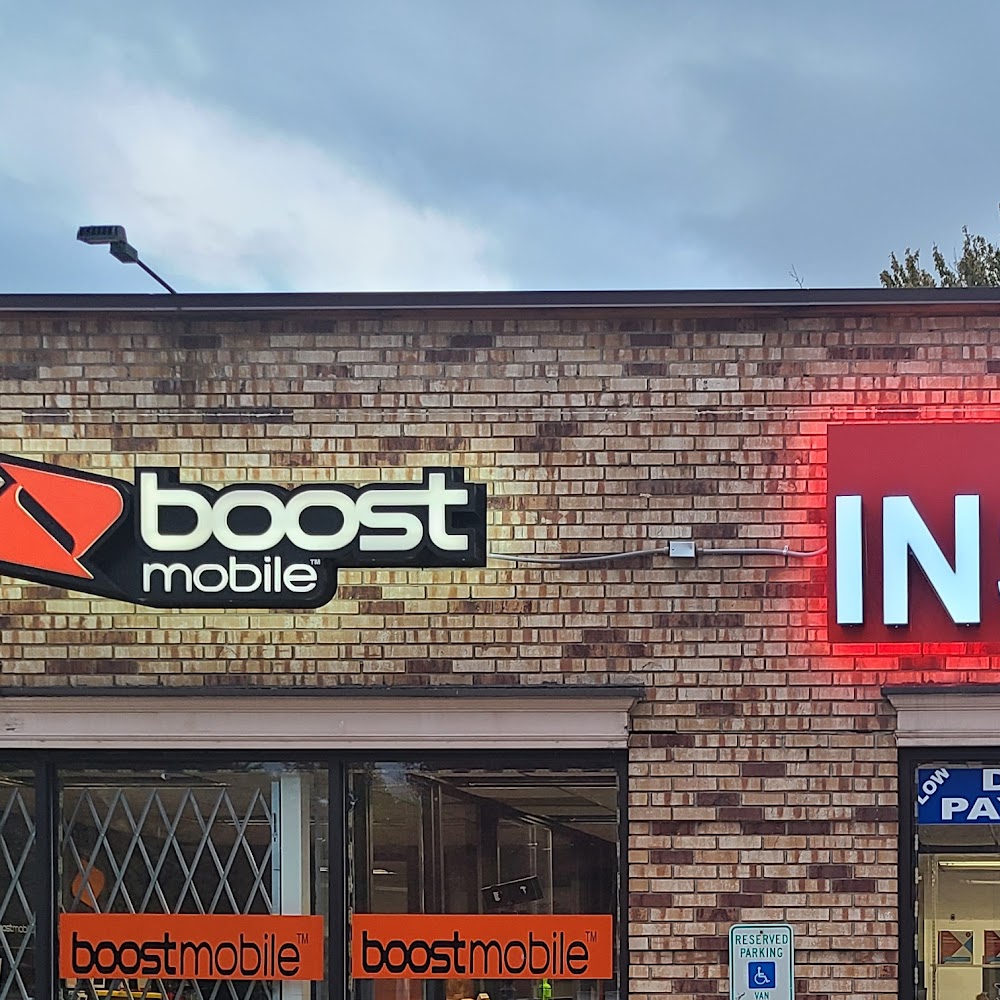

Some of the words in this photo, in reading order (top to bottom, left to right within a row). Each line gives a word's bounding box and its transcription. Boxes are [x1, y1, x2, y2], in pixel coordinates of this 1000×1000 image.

[140, 472, 468, 551] boost
[142, 556, 318, 593] mobile
[918, 767, 950, 805] LOW
[735, 934, 788, 945] RESERVED
[740, 947, 783, 958] PARKING
[754, 991, 770, 1000] VAN
